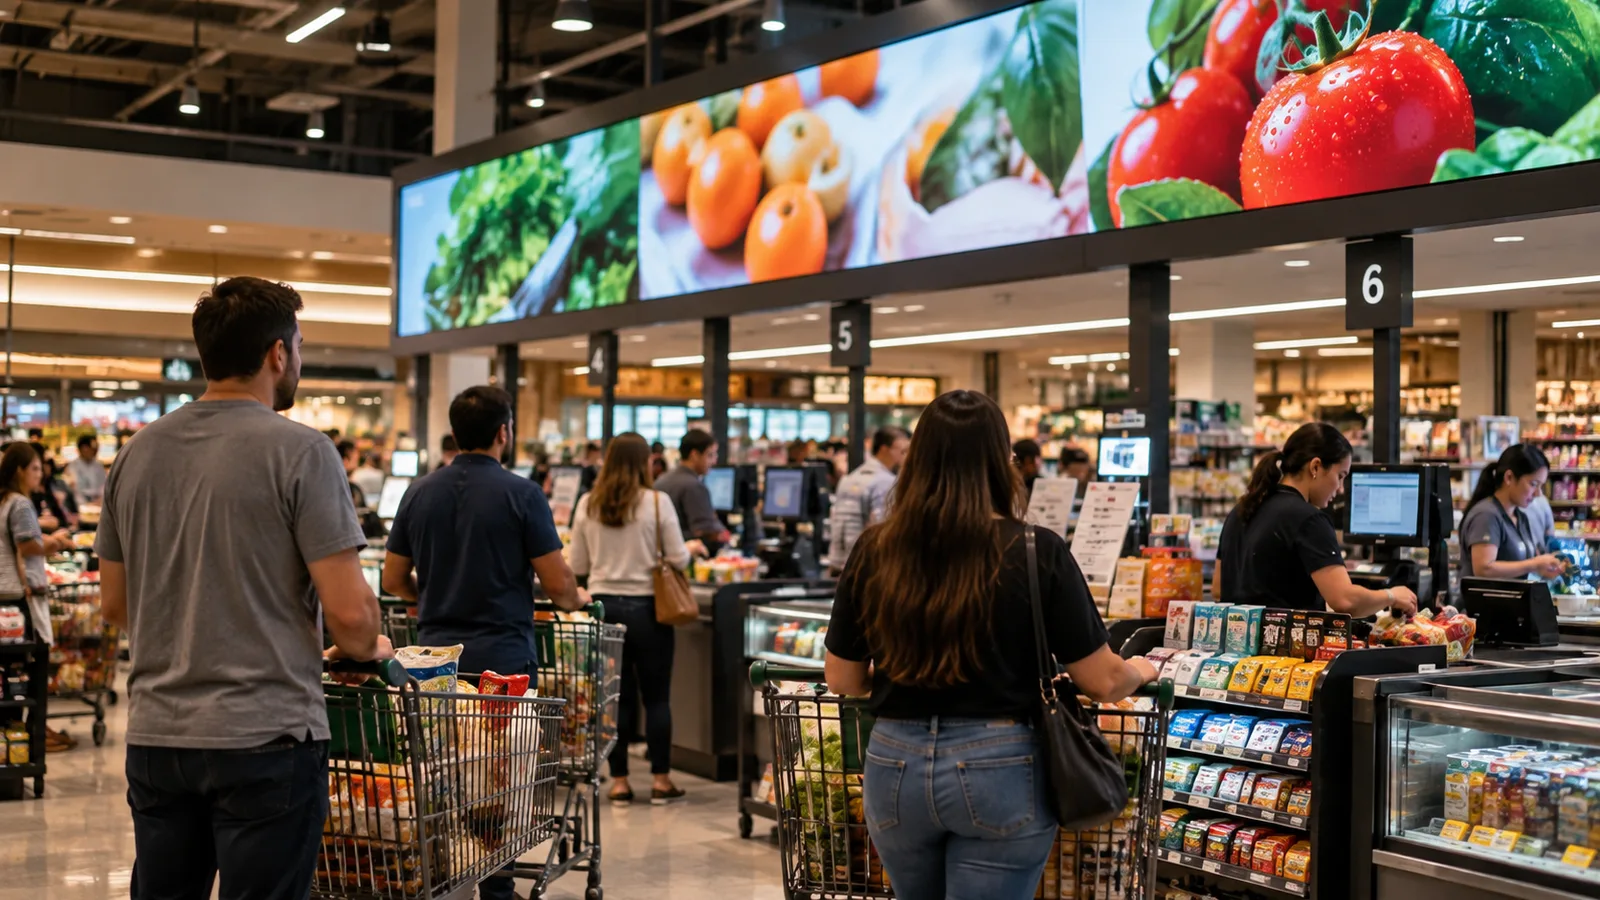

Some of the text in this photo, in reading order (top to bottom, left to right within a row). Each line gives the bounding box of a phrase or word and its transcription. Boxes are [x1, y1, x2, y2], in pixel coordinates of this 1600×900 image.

[1362, 263, 1384, 305] 6
[838, 320, 852, 351] 5
[590, 347, 604, 374] 4
